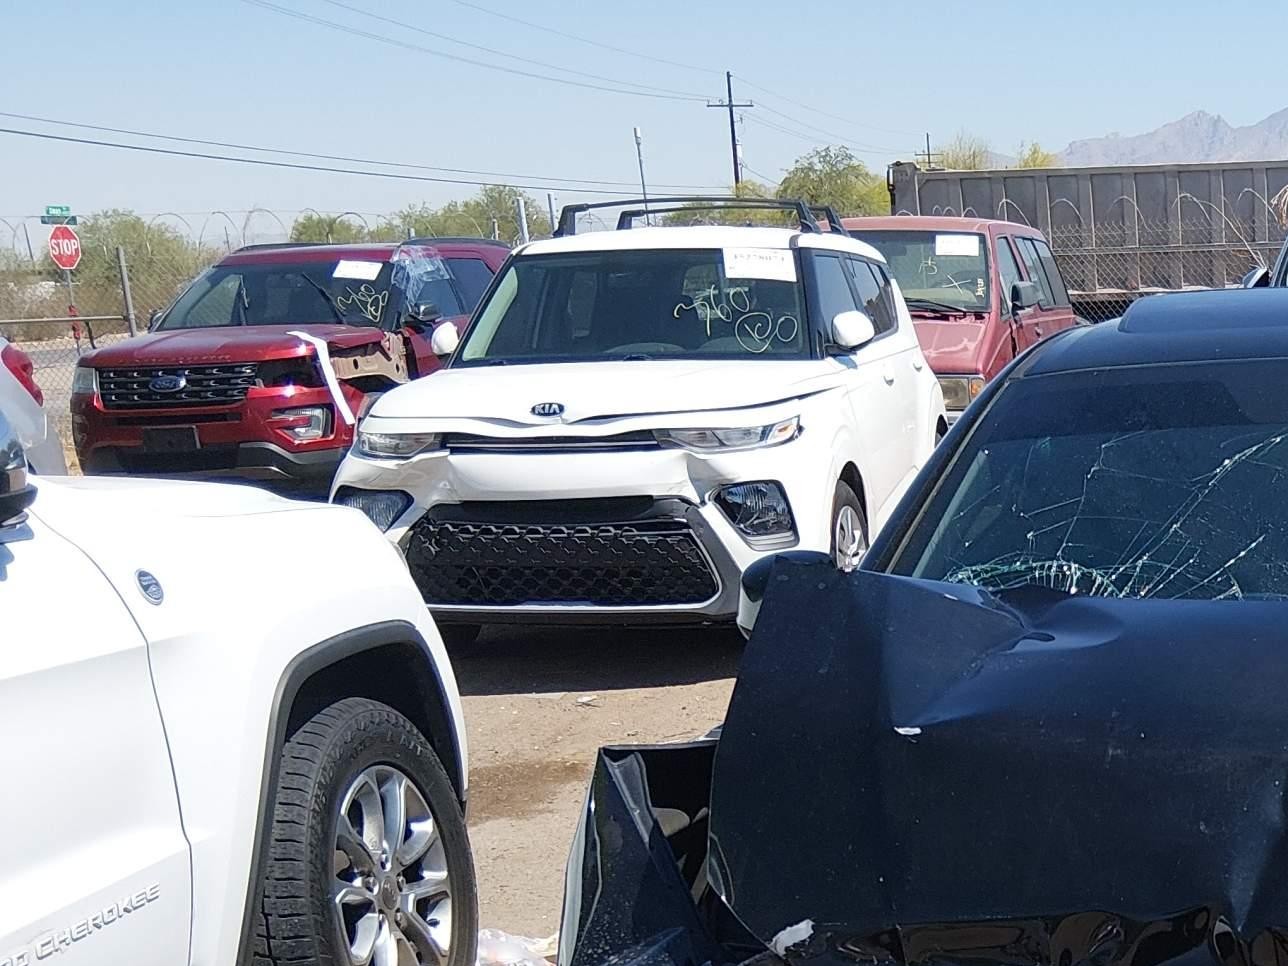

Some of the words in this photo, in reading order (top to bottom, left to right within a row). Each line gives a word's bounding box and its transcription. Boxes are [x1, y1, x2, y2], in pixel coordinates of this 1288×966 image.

[51, 239, 78, 255] STOP
[534, 403, 560, 414] KIA
[35, 881, 161, 961] CHEROKEE
